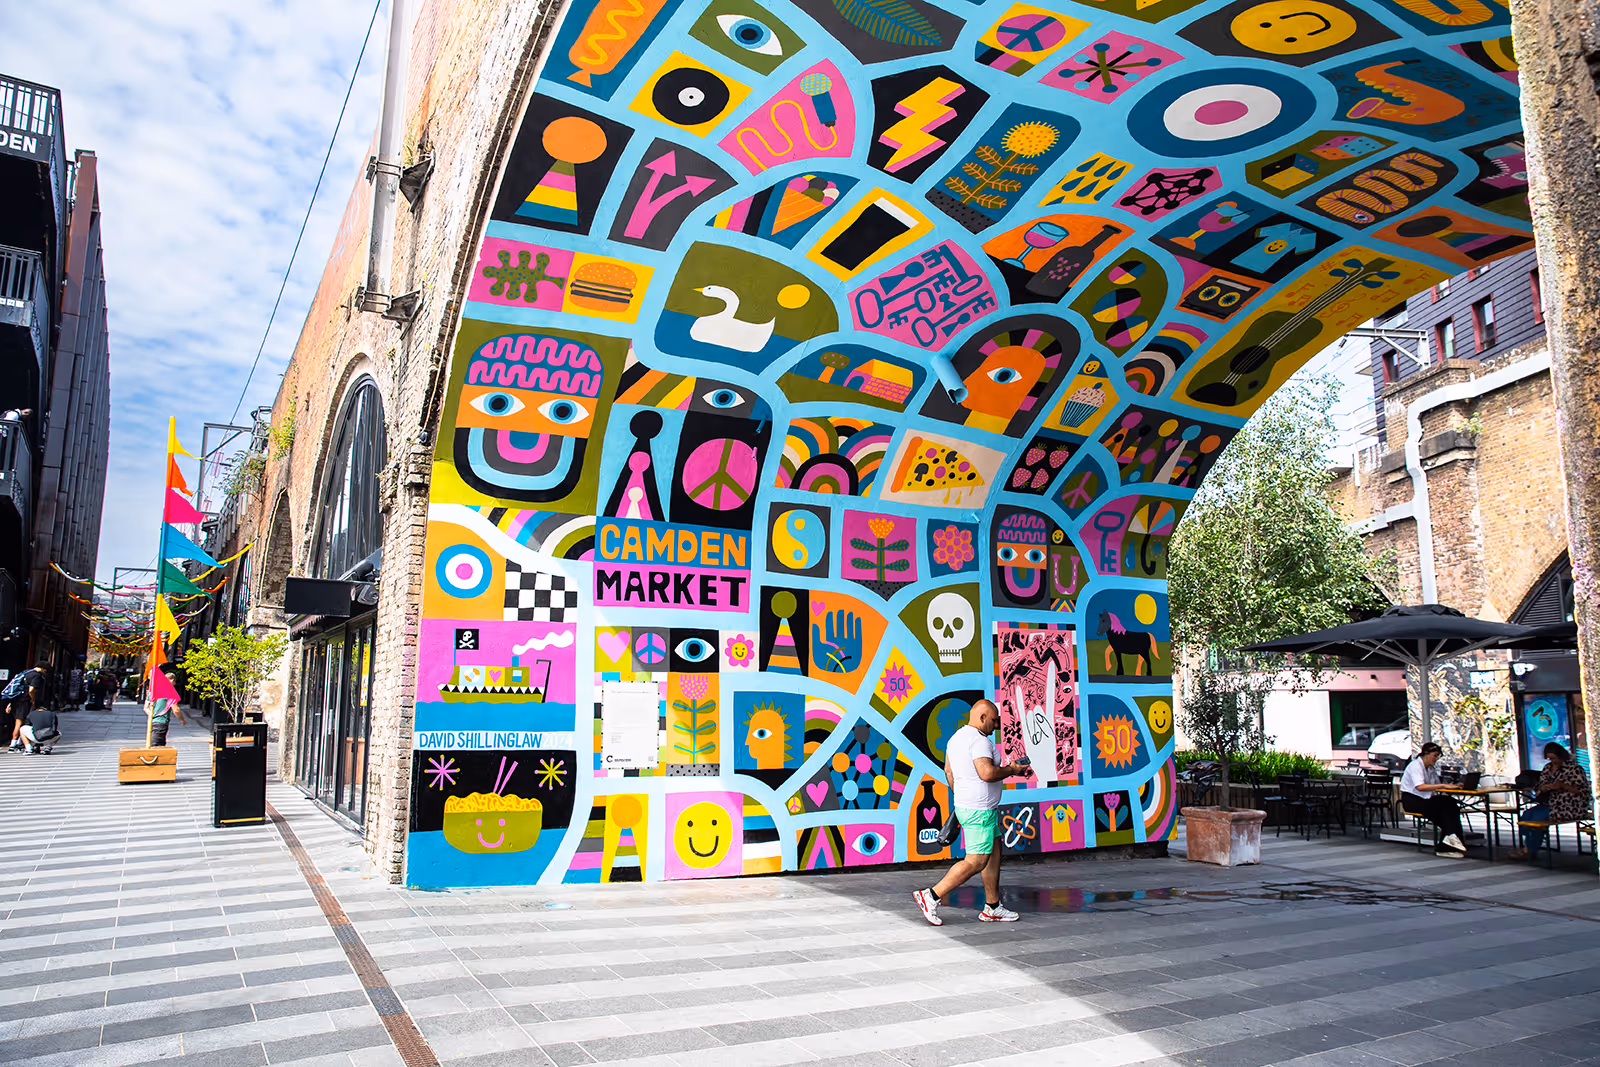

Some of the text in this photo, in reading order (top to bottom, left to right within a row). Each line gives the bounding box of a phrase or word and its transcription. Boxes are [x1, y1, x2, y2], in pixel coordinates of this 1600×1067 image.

[600, 524, 747, 567] CAMDEN
[596, 569, 747, 607] MARKET
[890, 677, 906, 692] 50
[419, 732, 455, 748] DAVID
[457, 732, 543, 748] SHILLINGLAW
[1103, 724, 1132, 755] 50
[920, 830, 939, 841] LOVE
